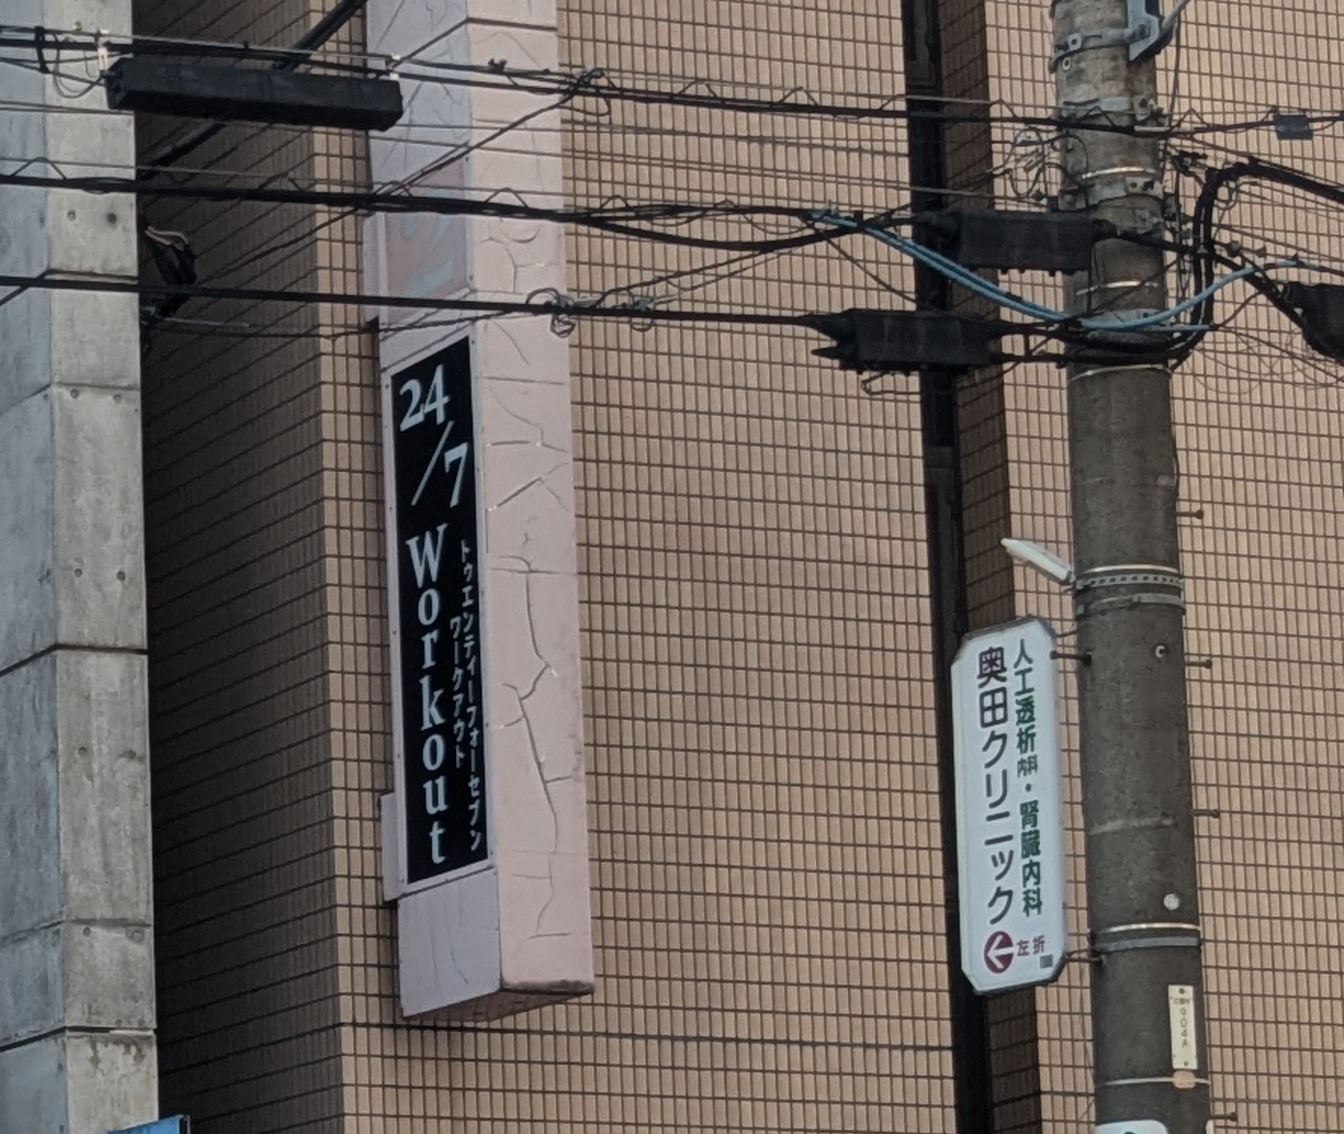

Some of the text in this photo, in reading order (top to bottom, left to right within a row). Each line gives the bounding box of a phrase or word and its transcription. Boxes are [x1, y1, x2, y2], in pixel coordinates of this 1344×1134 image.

[406, 522, 448, 865] Workout
[449, 615, 468, 769] ワークアウト
[976, 645, 1015, 926] 奥田クリニック
[1016, 935, 1046, 959] 左折
